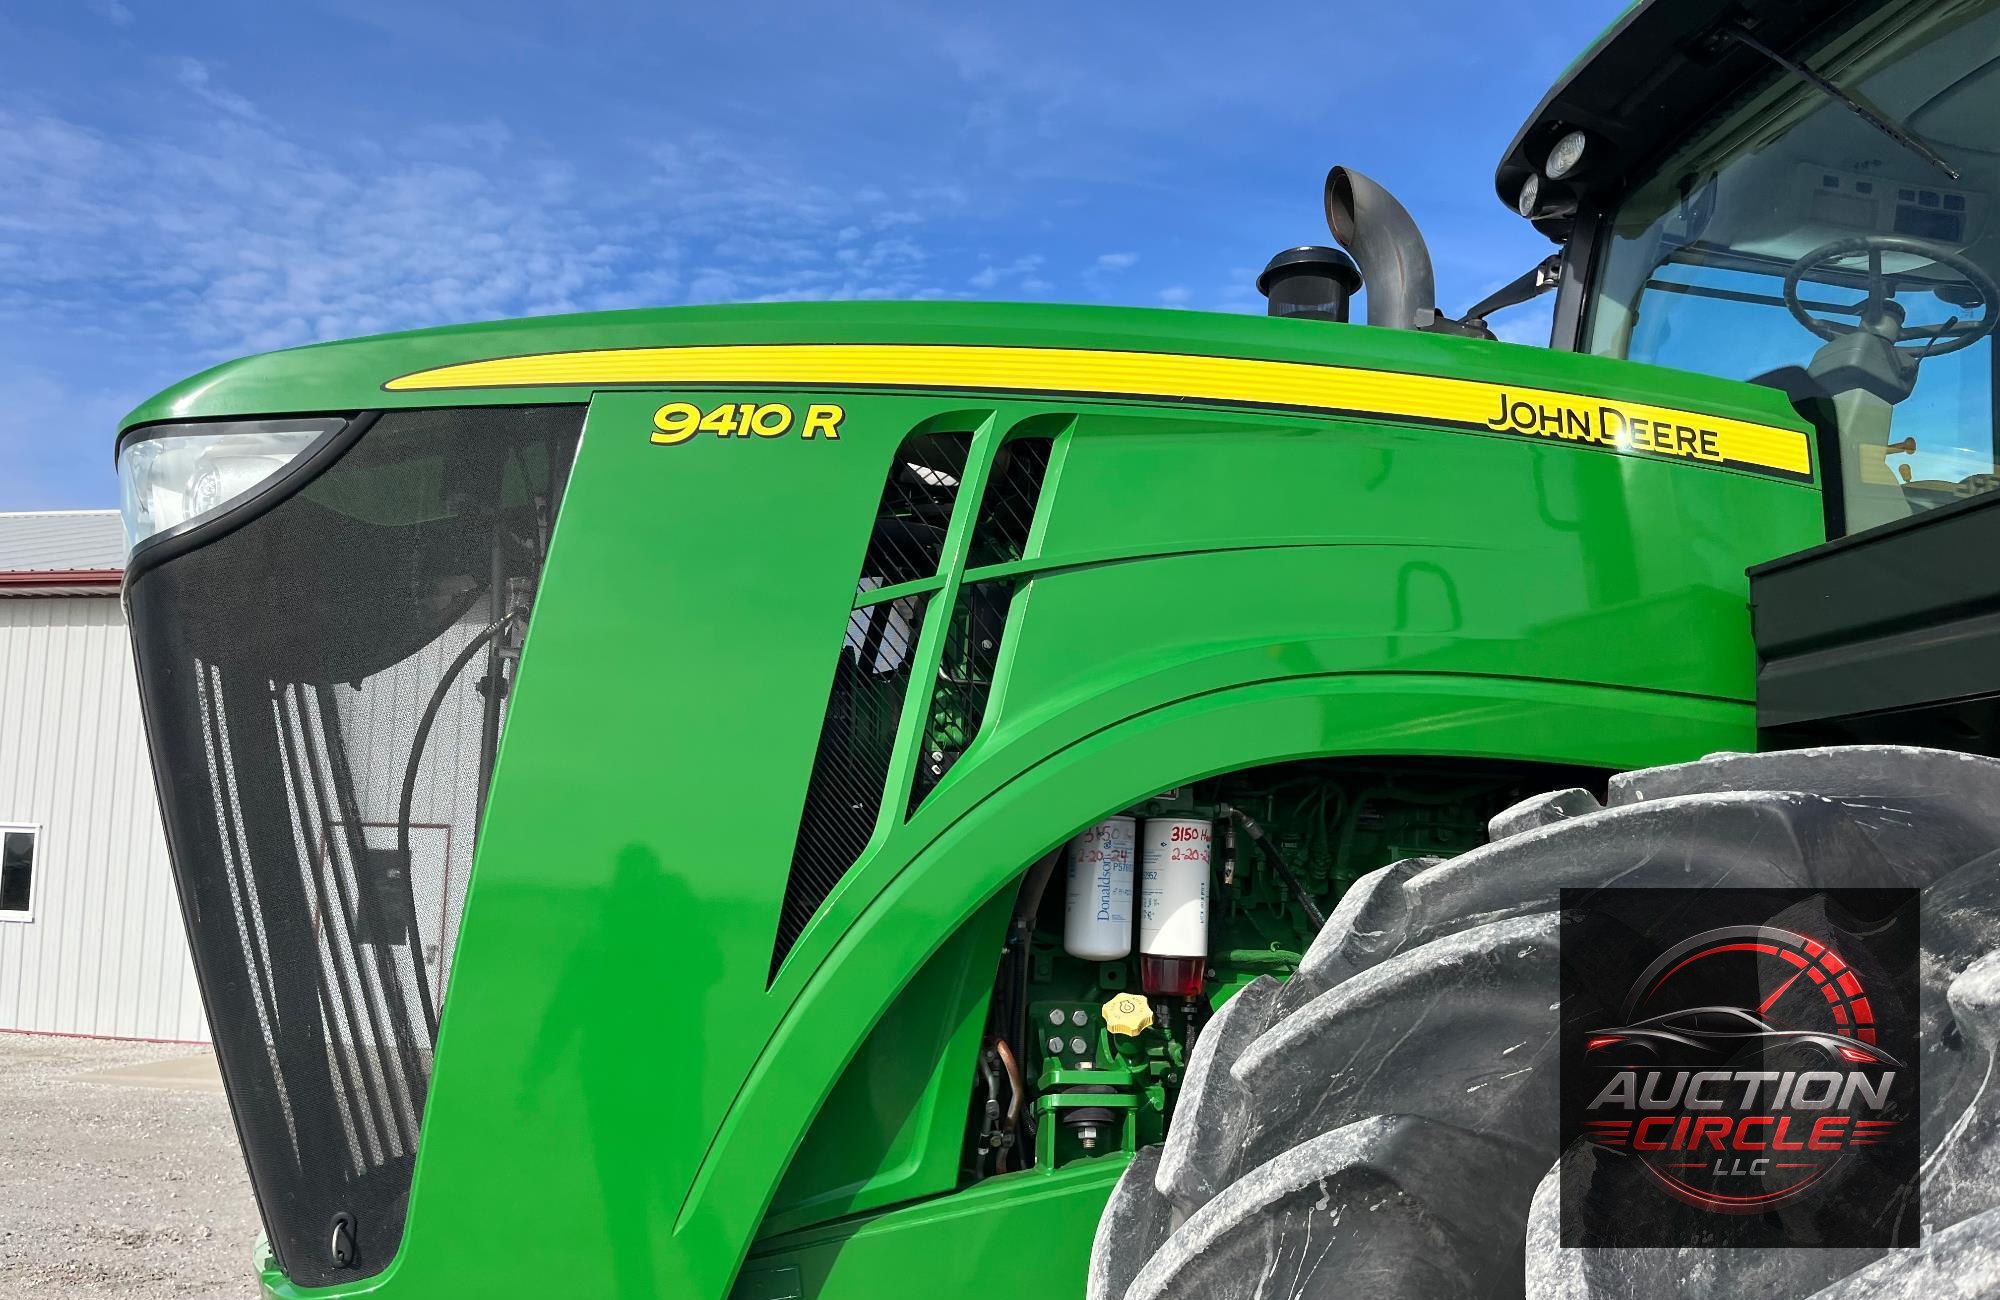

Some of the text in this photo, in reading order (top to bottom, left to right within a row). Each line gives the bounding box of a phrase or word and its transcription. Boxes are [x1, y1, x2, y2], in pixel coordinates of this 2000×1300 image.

[650, 402, 845, 446] 9410 R
[1488, 394, 1720, 457] JOHN DEERE
[1171, 826, 1199, 842] 3150
[1097, 853, 1112, 921] Donaldson
